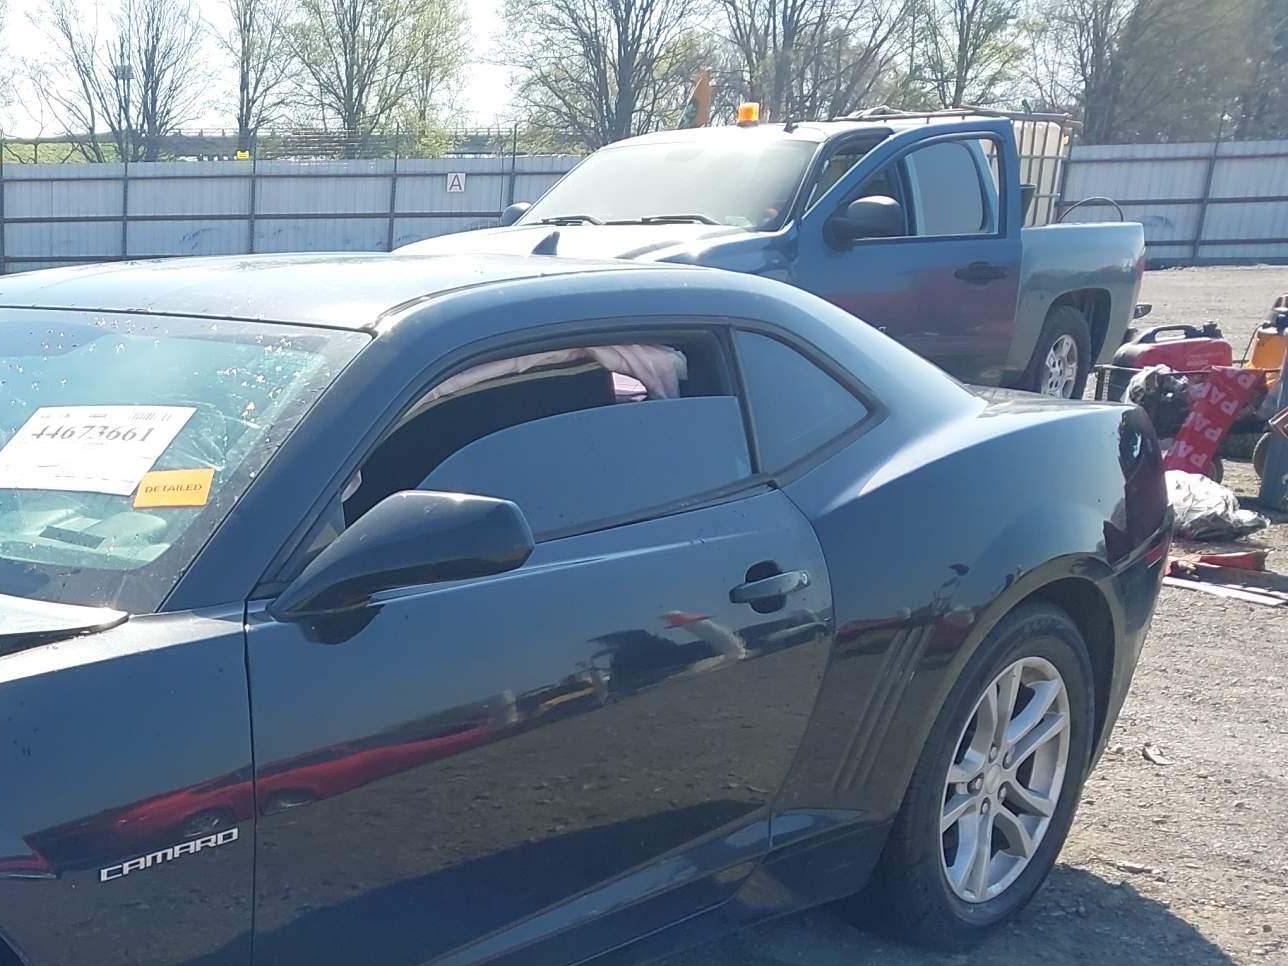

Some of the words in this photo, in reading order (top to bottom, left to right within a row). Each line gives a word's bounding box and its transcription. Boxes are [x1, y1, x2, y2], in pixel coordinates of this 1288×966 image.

[449, 173, 462, 190] A
[31, 424, 155, 442] 44673661
[144, 483, 203, 494] DETAILED
[100, 827, 239, 882] CAMARO
